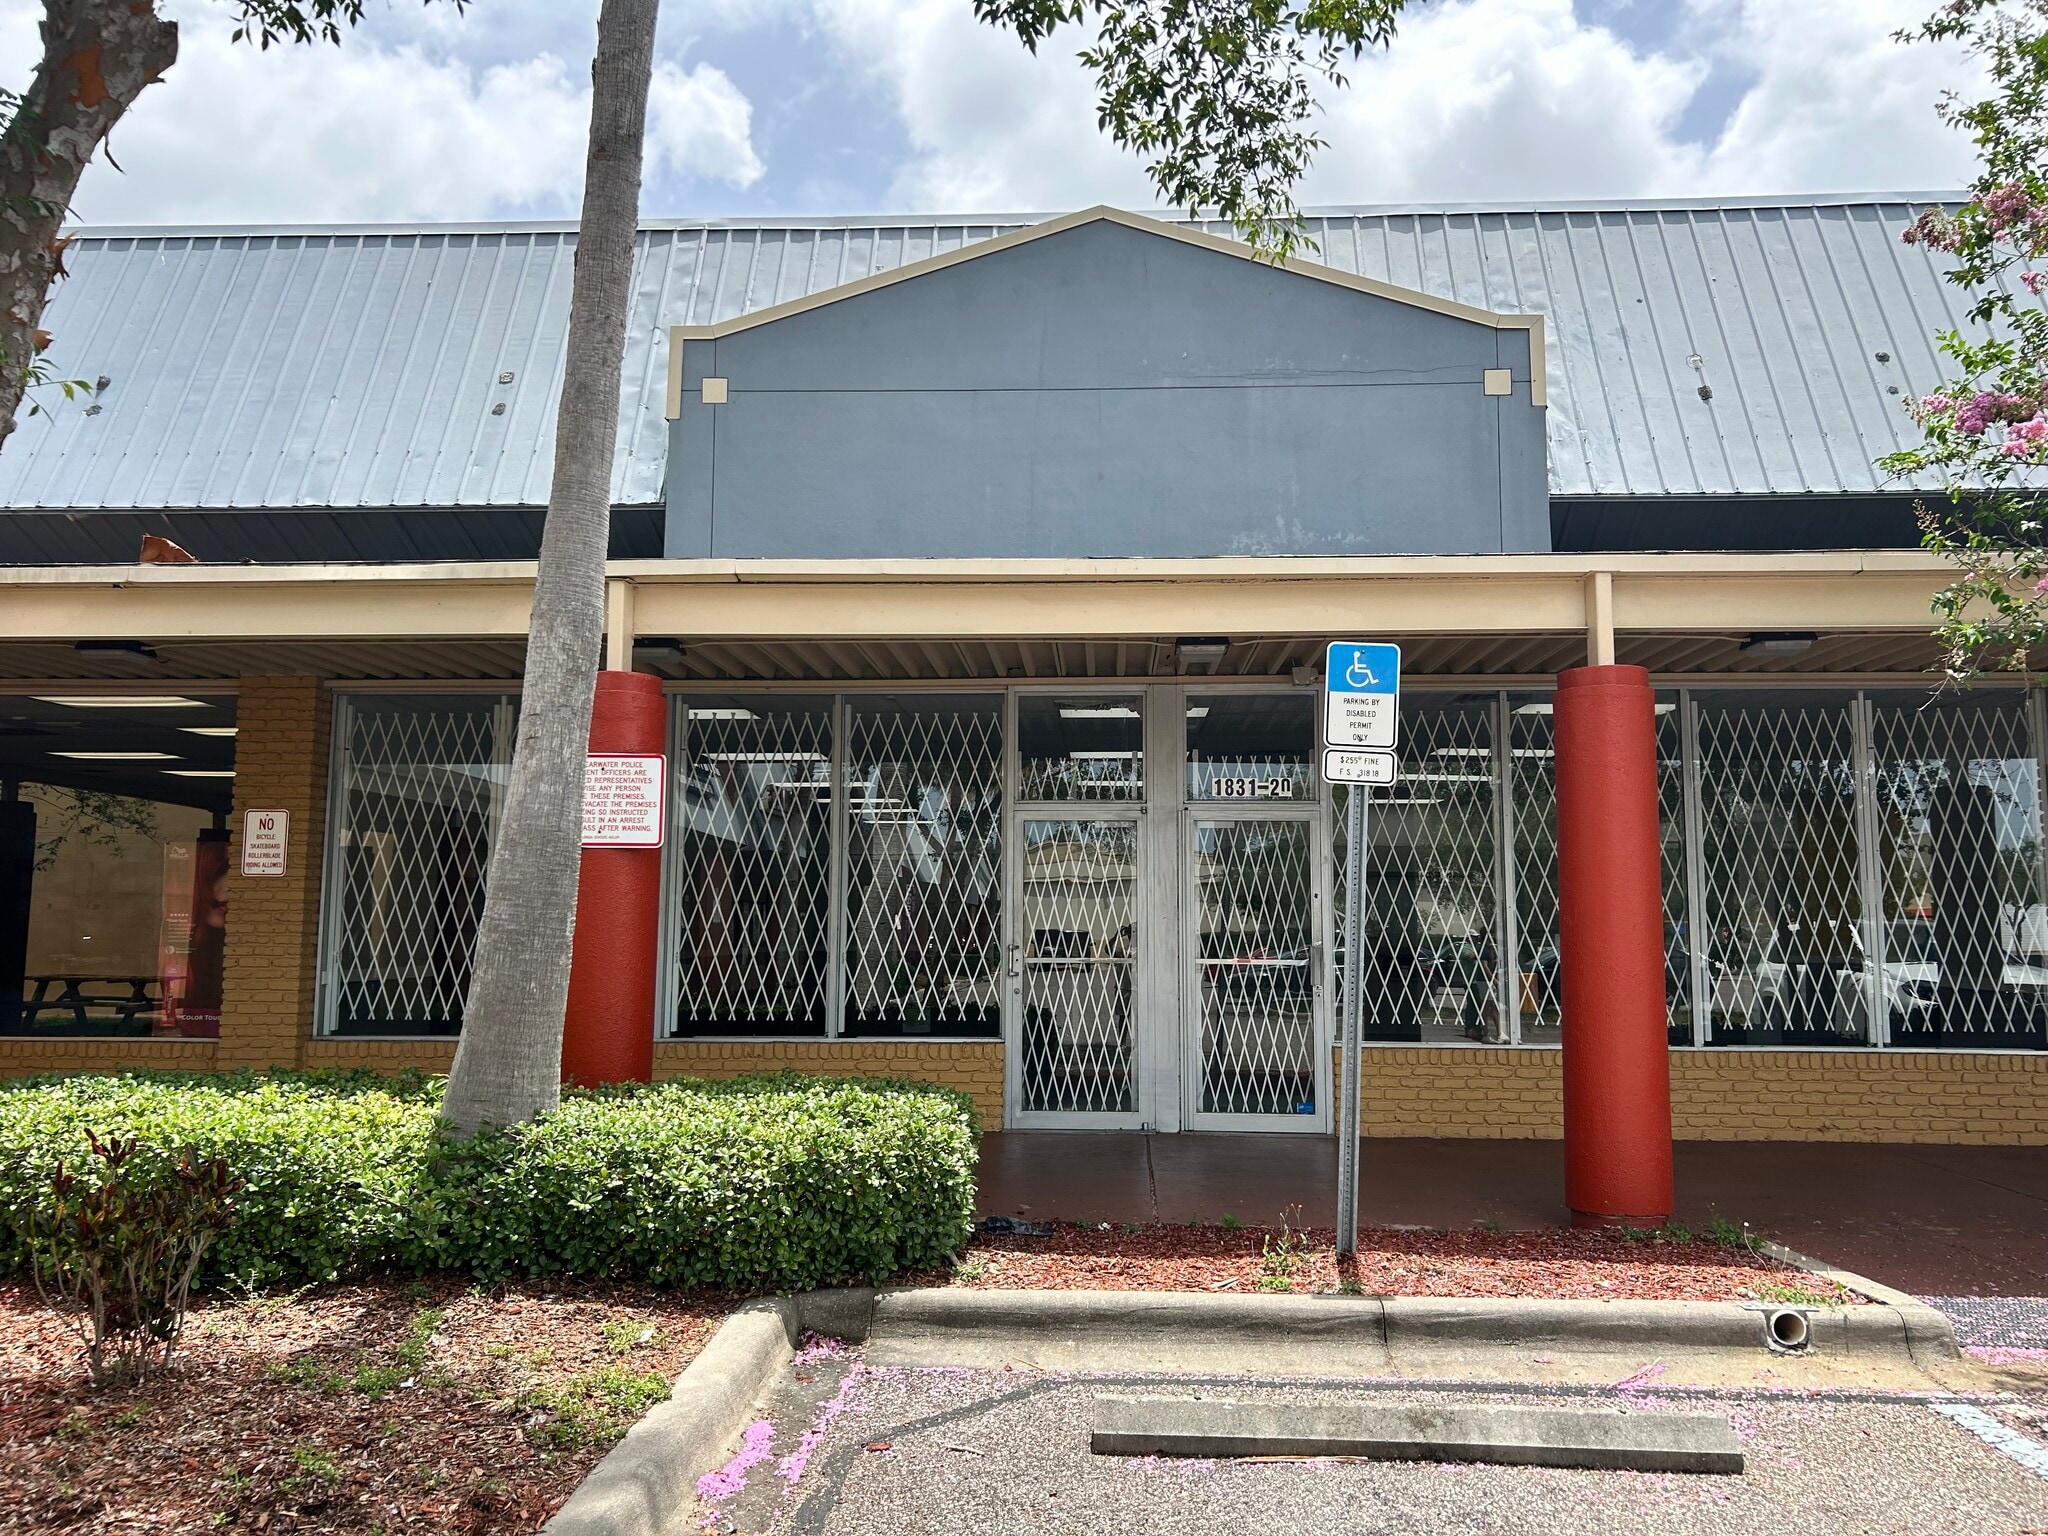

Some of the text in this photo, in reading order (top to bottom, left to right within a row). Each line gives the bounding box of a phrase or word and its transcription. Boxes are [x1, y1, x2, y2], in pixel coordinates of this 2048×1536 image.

[1343, 697, 1369, 706] PARKING
[1346, 709, 1376, 718] DISABLED
[1364, 757, 1380, 765] FINE
[259, 818, 275, 831] NO
